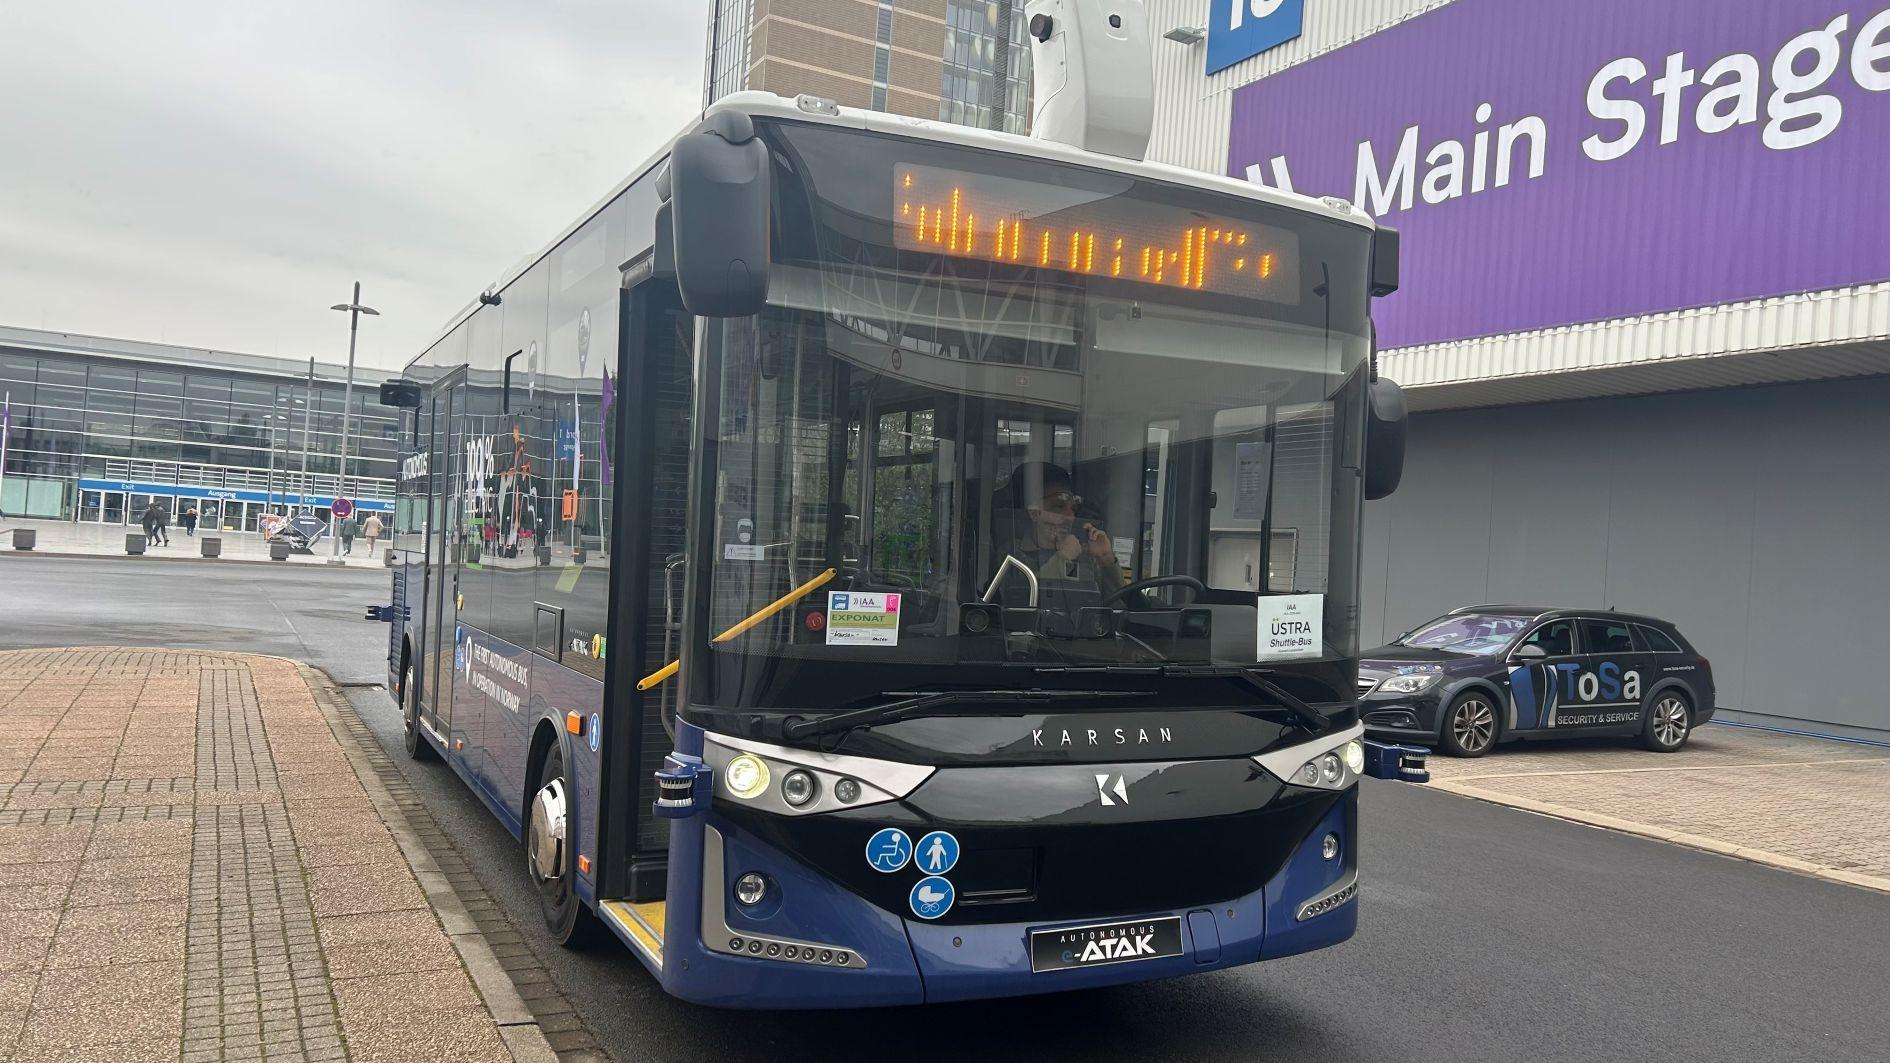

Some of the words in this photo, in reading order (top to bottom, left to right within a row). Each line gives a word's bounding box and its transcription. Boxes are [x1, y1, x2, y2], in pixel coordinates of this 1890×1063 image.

[1352, 103, 1547, 218] Main
[1582, 8, 1890, 161] Stage
[121, 483, 134, 491] Exit
[208, 489, 237, 499] Ausgang
[831, 614, 886, 622] EXPONAT
[1269, 637, 1312, 648] Shuttle-Bus
[1557, 661, 1640, 701] ToSa
[1557, 714, 1597, 725] SECURITY
[1598, 714, 1604, 723] &
[1605, 712, 1640, 722] SERVICE
[1032, 727, 1172, 746] KARSAN
[1060, 925, 1155, 943] AUTONOMOUS
[1061, 934, 1157, 963] e-ATAK
